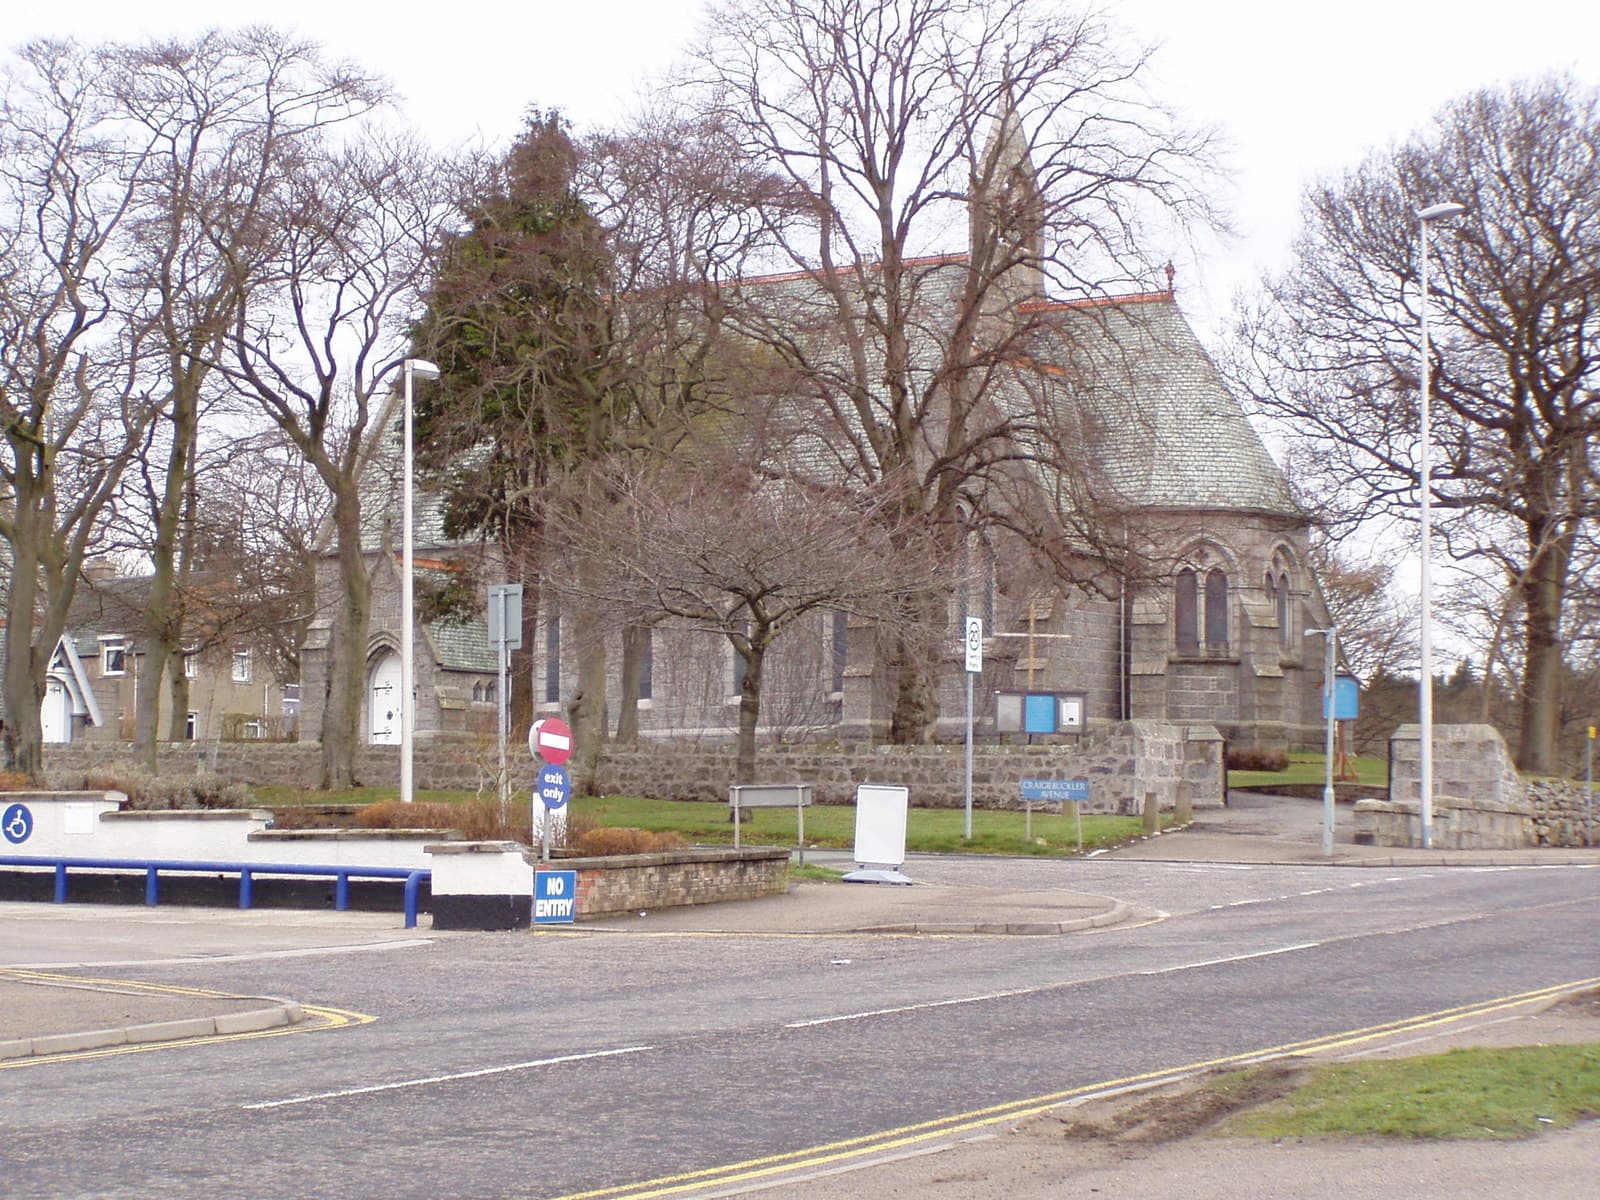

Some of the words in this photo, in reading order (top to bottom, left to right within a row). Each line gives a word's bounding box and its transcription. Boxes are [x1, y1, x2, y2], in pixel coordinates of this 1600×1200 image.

[544, 773, 563, 785] exit
[543, 788, 564, 802] only
[546, 877, 564, 895] NO
[536, 898, 573, 917] ENTRY
